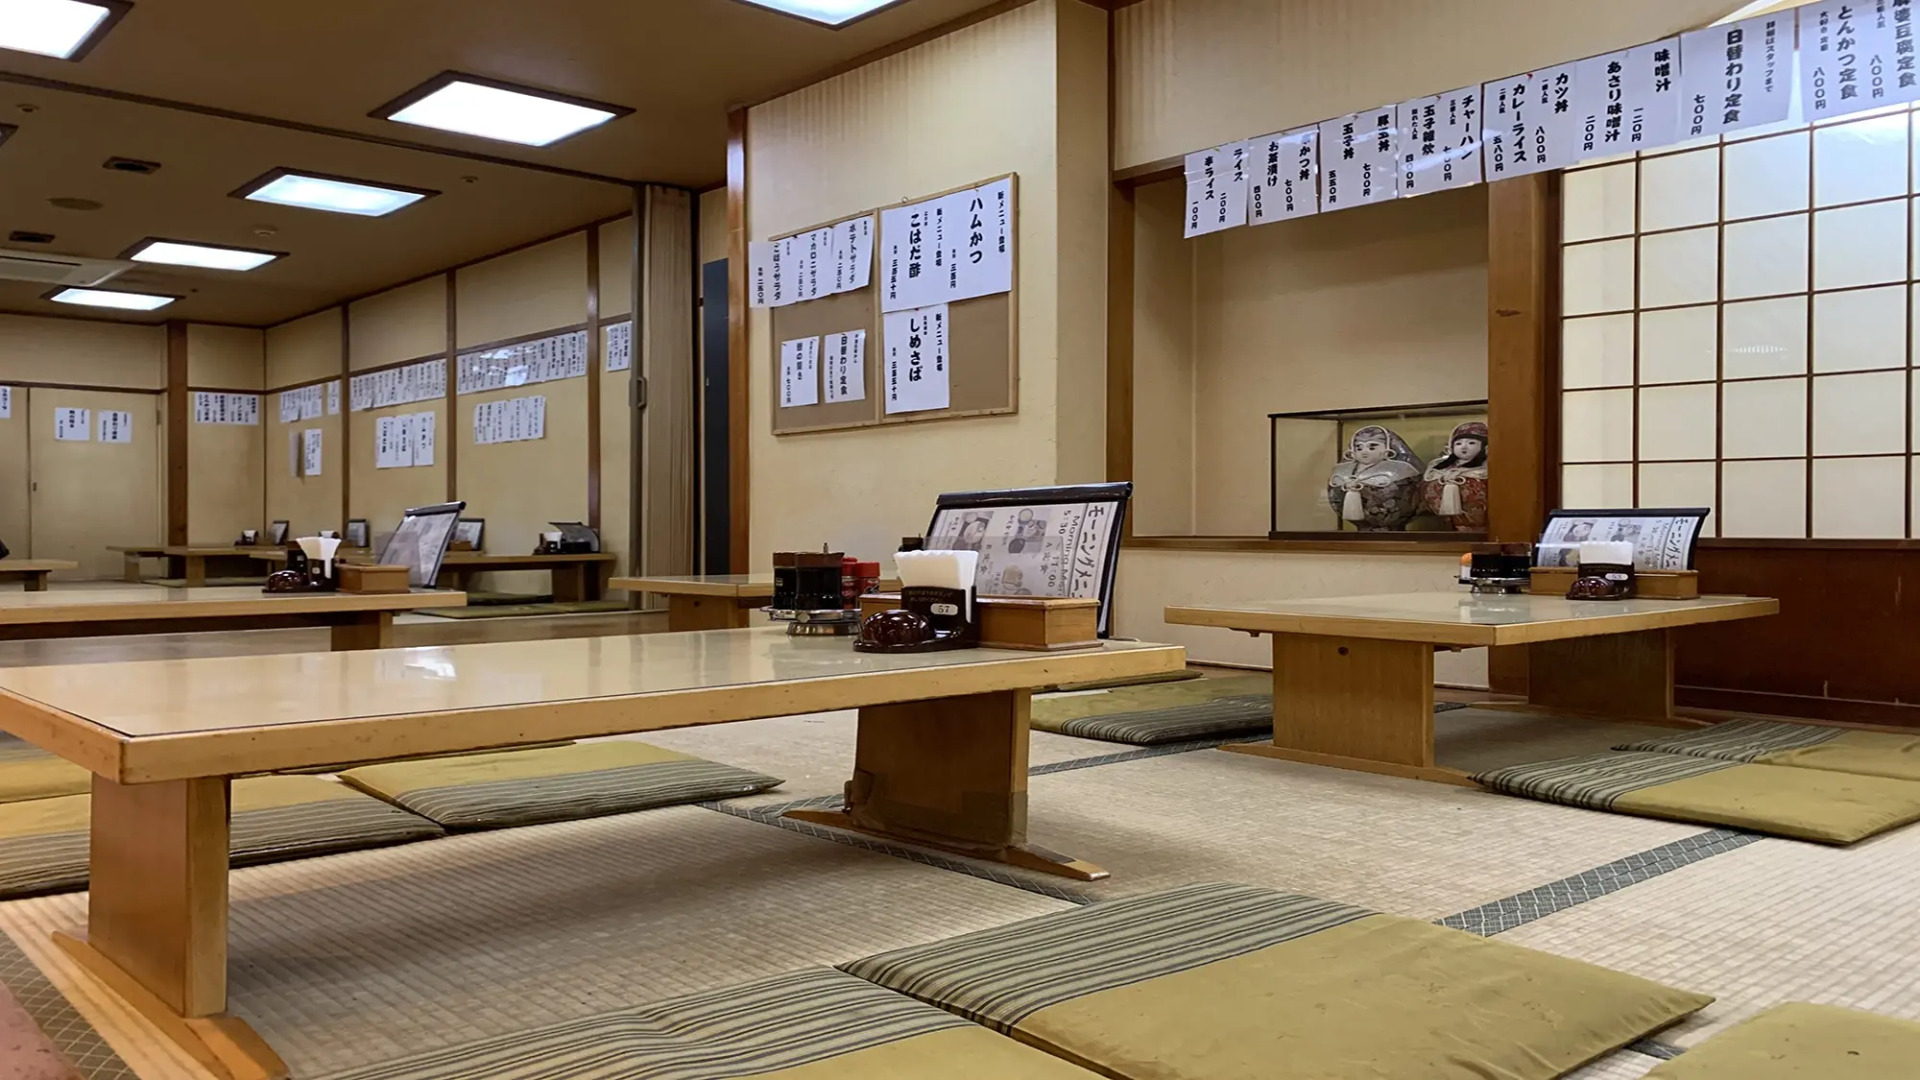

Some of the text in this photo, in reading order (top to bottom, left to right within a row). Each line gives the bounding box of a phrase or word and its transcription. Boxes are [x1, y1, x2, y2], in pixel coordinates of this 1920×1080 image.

[1654, 48, 1672, 93] 味噌汁
[1764, 20, 1776, 93] 詳細はスタッフまで
[1837, 5, 1858, 100] とんかつ定食
[1554, 72, 1569, 114] カツ丼
[1723, 28, 1743, 125] 日替わり定食
[1813, 66, 1827, 110] 八〇〇円
[1869, 54, 1884, 99] 八〇〇円
[1511, 83, 1527, 164] カレーライス
[1604, 61, 1623, 143] あさり味噌汁
[1631, 107, 1644, 143] 一二〇円
[1690, 94, 1705, 135] 七〇〇円
[1342, 122, 1355, 160] 玉子丼
[1422, 104, 1436, 156] 玉子雑炊
[1460, 95, 1475, 160] チャーハン
[1535, 126, 1547, 164] 八〇〇円
[1583, 115, 1596, 151] 二〇〇円
[1204, 155, 1215, 201] 半ライス
[1233, 148, 1243, 182] ライス
[1267, 141, 1279, 187] お茶漬け
[1298, 132, 1312, 182] かつ丼
[1362, 163, 1371, 197] 七〇〇円
[1443, 146, 1452, 182] 七〇円
[1191, 201, 1199, 230] 一〇〇円
[1218, 192, 1227, 223] 二〇〇円
[1284, 179, 1294, 212] 七〇〇円
[908, 213, 922, 279] こはだ酢
[969, 197, 984, 264] ハムかつ
[809, 232, 817, 296] マカロニサラダ
[839, 335, 848, 396] 日替わり定食
[908, 318, 924, 382] しめさば
[1062, 514, 1081, 566] Morning
[1665, 518, 1689, 569] モーニングメニ
[937, 605, 950, 613] 57
